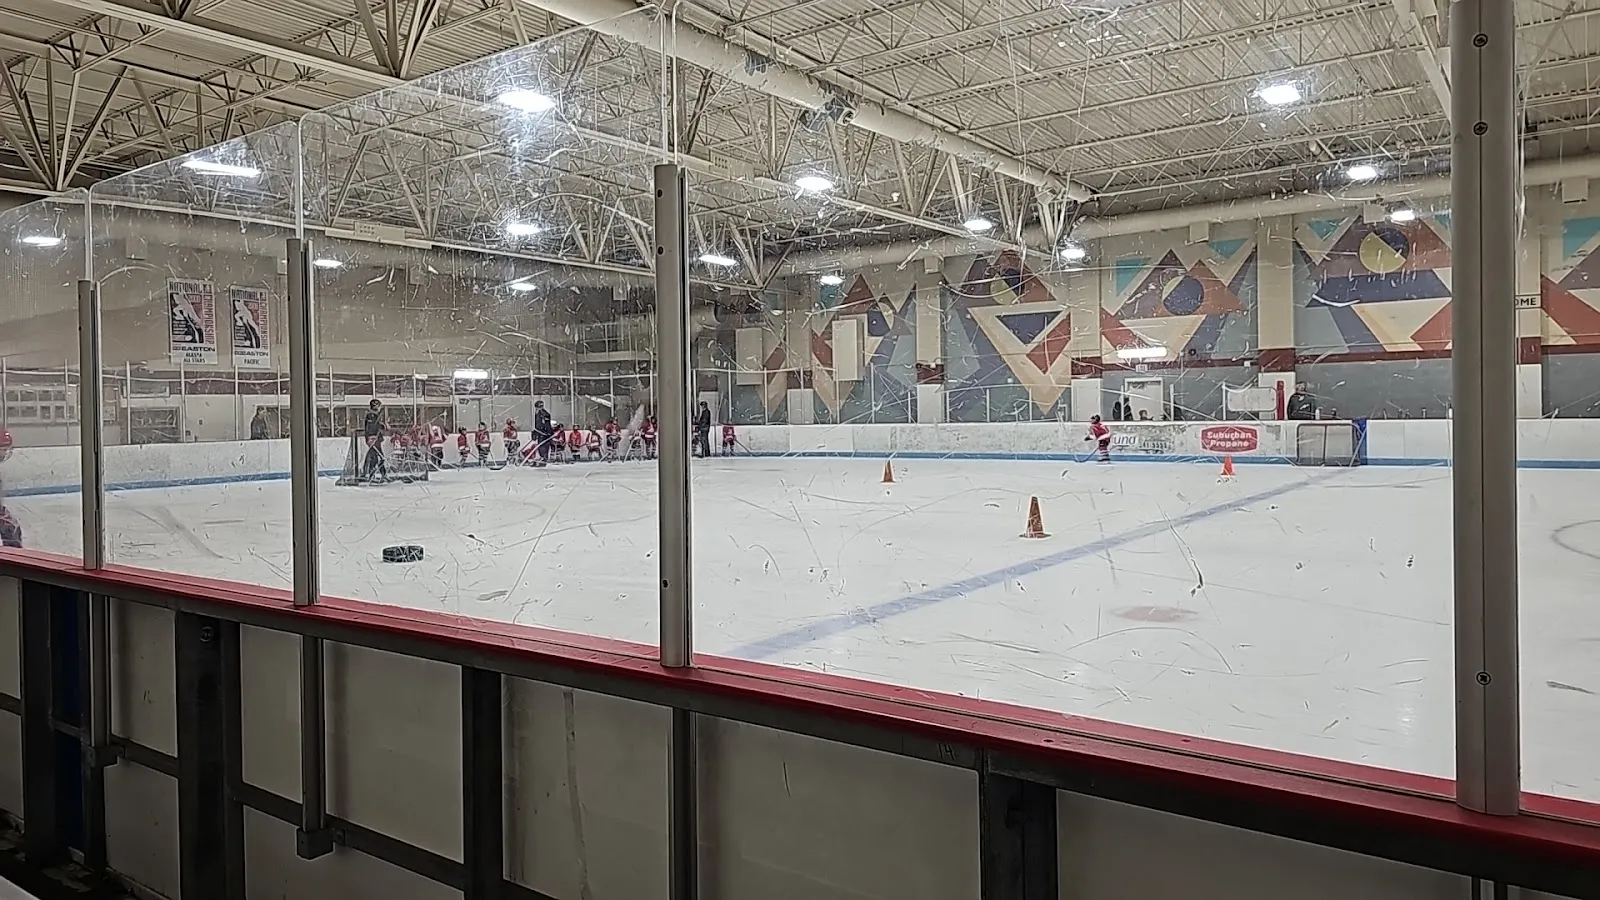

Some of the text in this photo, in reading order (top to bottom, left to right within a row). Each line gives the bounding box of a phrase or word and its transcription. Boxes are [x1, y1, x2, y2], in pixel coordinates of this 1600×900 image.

[169, 281, 203, 293] NATIONAL
[231, 289, 260, 300] NATIONAL
[203, 294, 215, 345] CHAMPIONSHIP
[260, 301, 269, 350] CHAMPIONSHIP
[1207, 431, 1251, 439] Suburban
[1210, 440, 1250, 448] Propane
